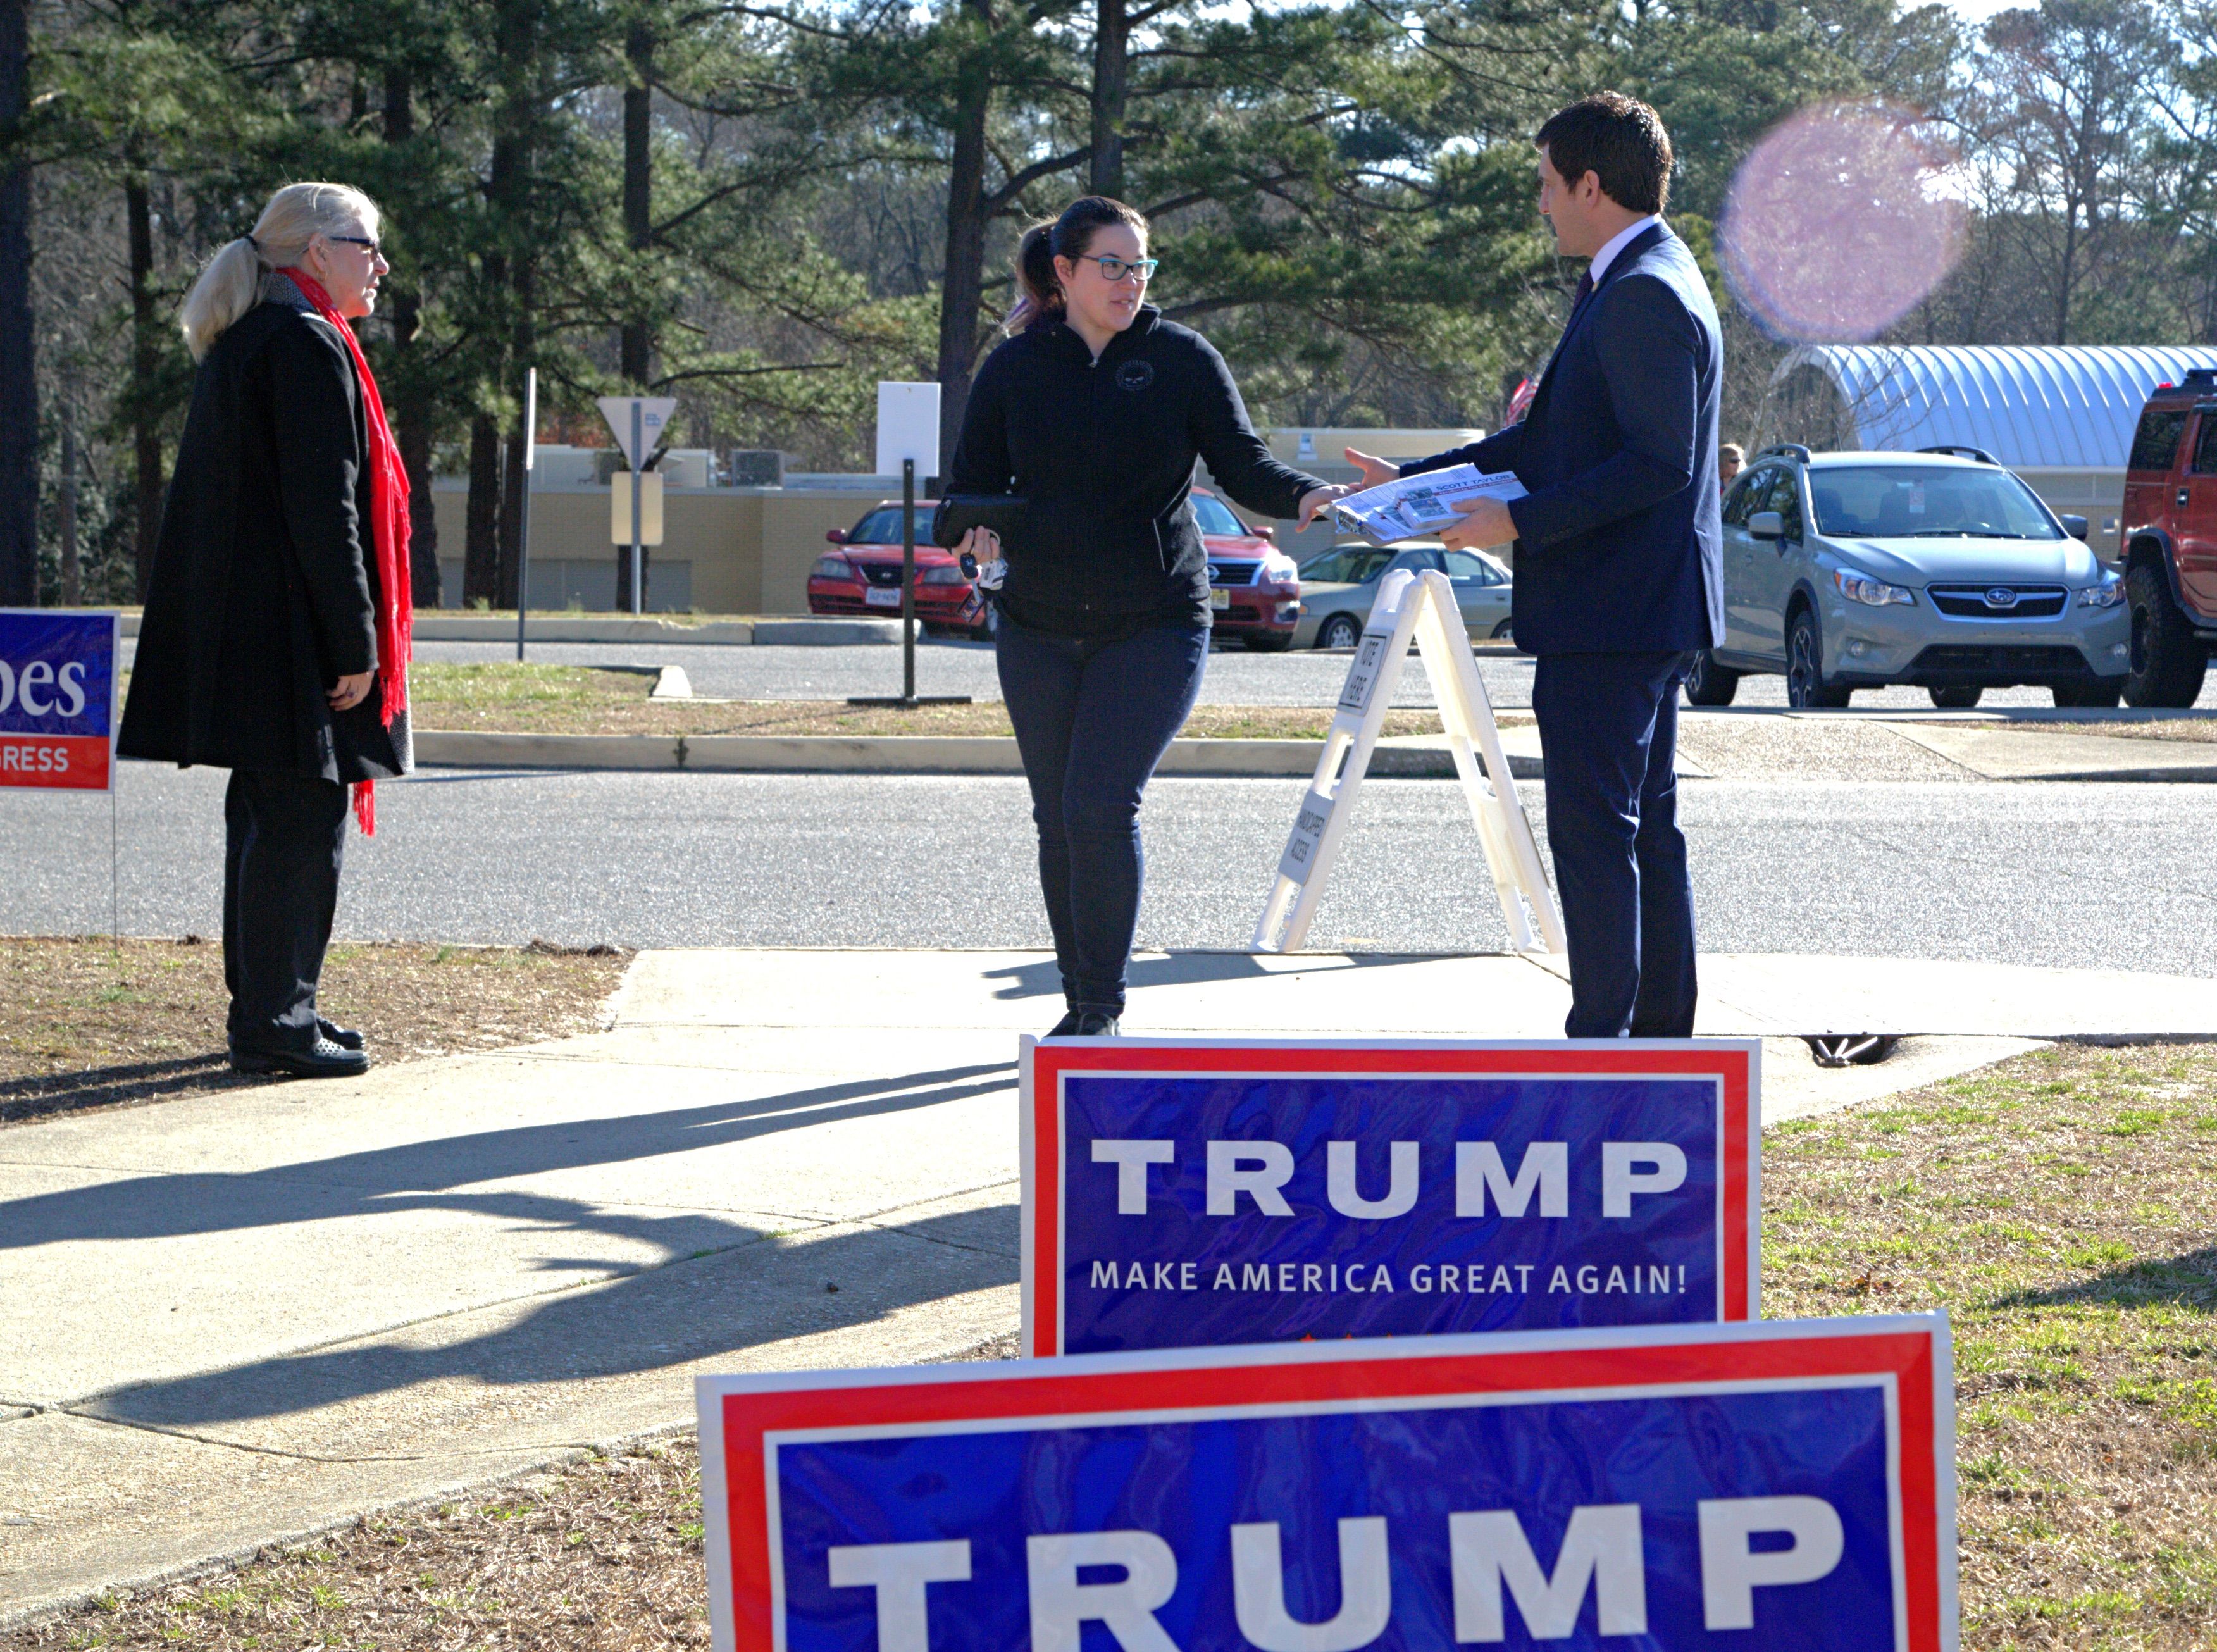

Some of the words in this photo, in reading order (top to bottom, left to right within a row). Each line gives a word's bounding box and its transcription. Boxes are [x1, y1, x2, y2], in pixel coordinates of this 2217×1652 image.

[1436, 481, 1468, 490] SCOTT
[1470, 475, 1510, 484] TAYLOR
[1360, 640, 1379, 666] VOTE
[1347, 675, 1367, 701] HERE
[0, 745, 68, 772] RESS
[1091, 1139, 1687, 1219] TRUMP
[1091, 1261, 1198, 1291] MAKE
[1212, 1262, 1394, 1293] AMERICA
[1410, 1264, 1535, 1294] GREAT
[1548, 1265, 1686, 1294] AGAIN!
[828, 1496, 1844, 1652] TRUMP
